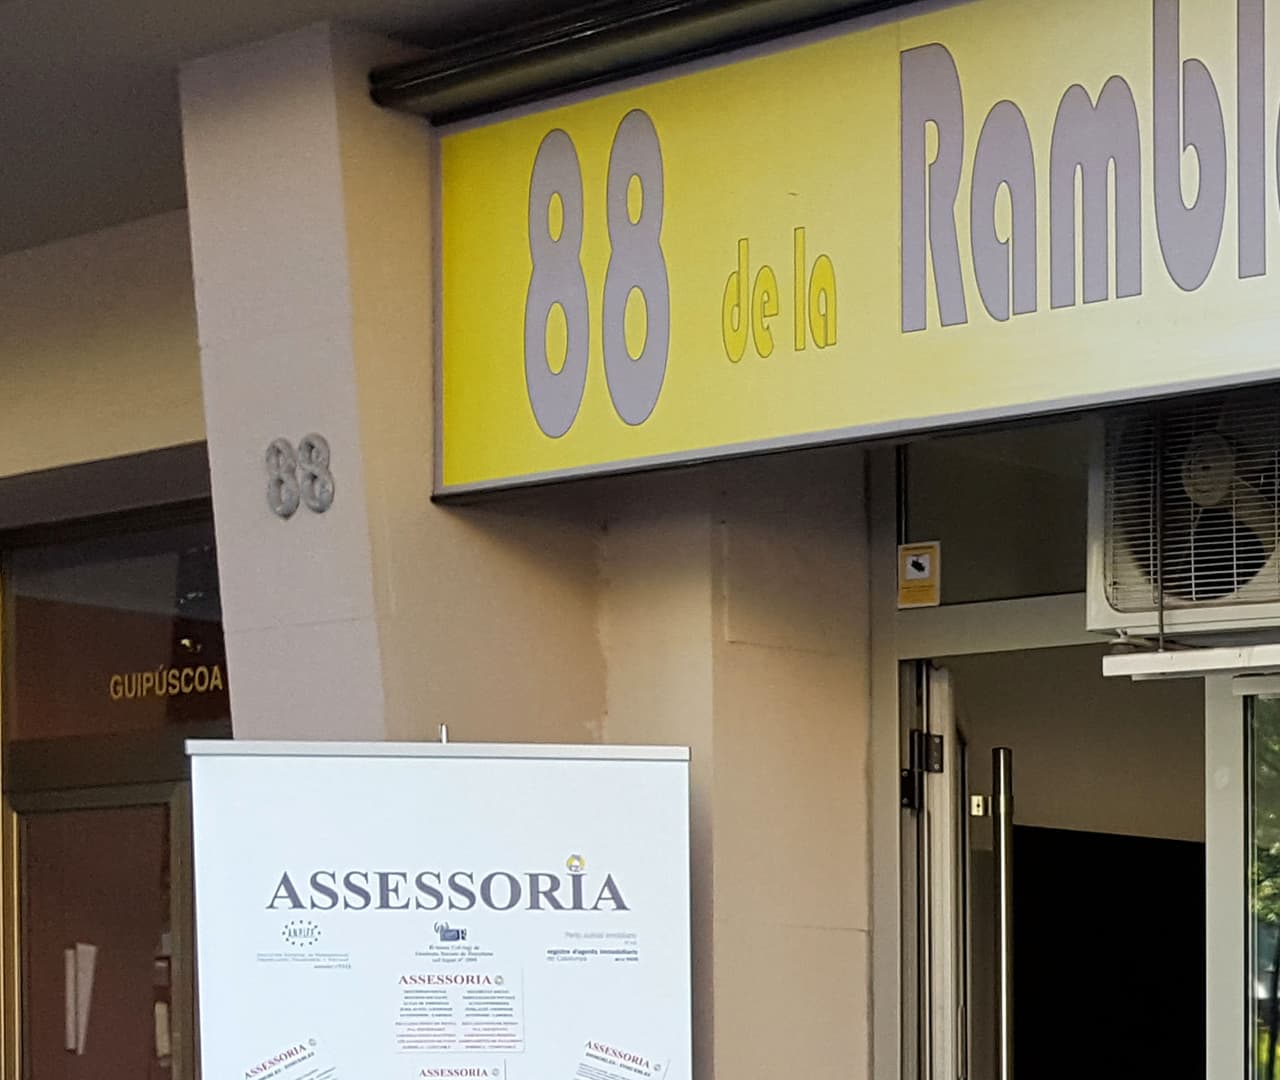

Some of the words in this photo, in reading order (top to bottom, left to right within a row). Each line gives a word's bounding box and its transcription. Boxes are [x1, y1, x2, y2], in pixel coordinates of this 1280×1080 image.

[523, 107, 671, 439] 88
[722, 238, 779, 364] de
[794, 226, 838, 351] la
[265, 433, 335, 520] 88
[110, 664, 223, 699] GUIPÚSCOA
[398, 974, 492, 985] ASSESSORIA
[419, 1068, 488, 1078] ASSESSORIA
